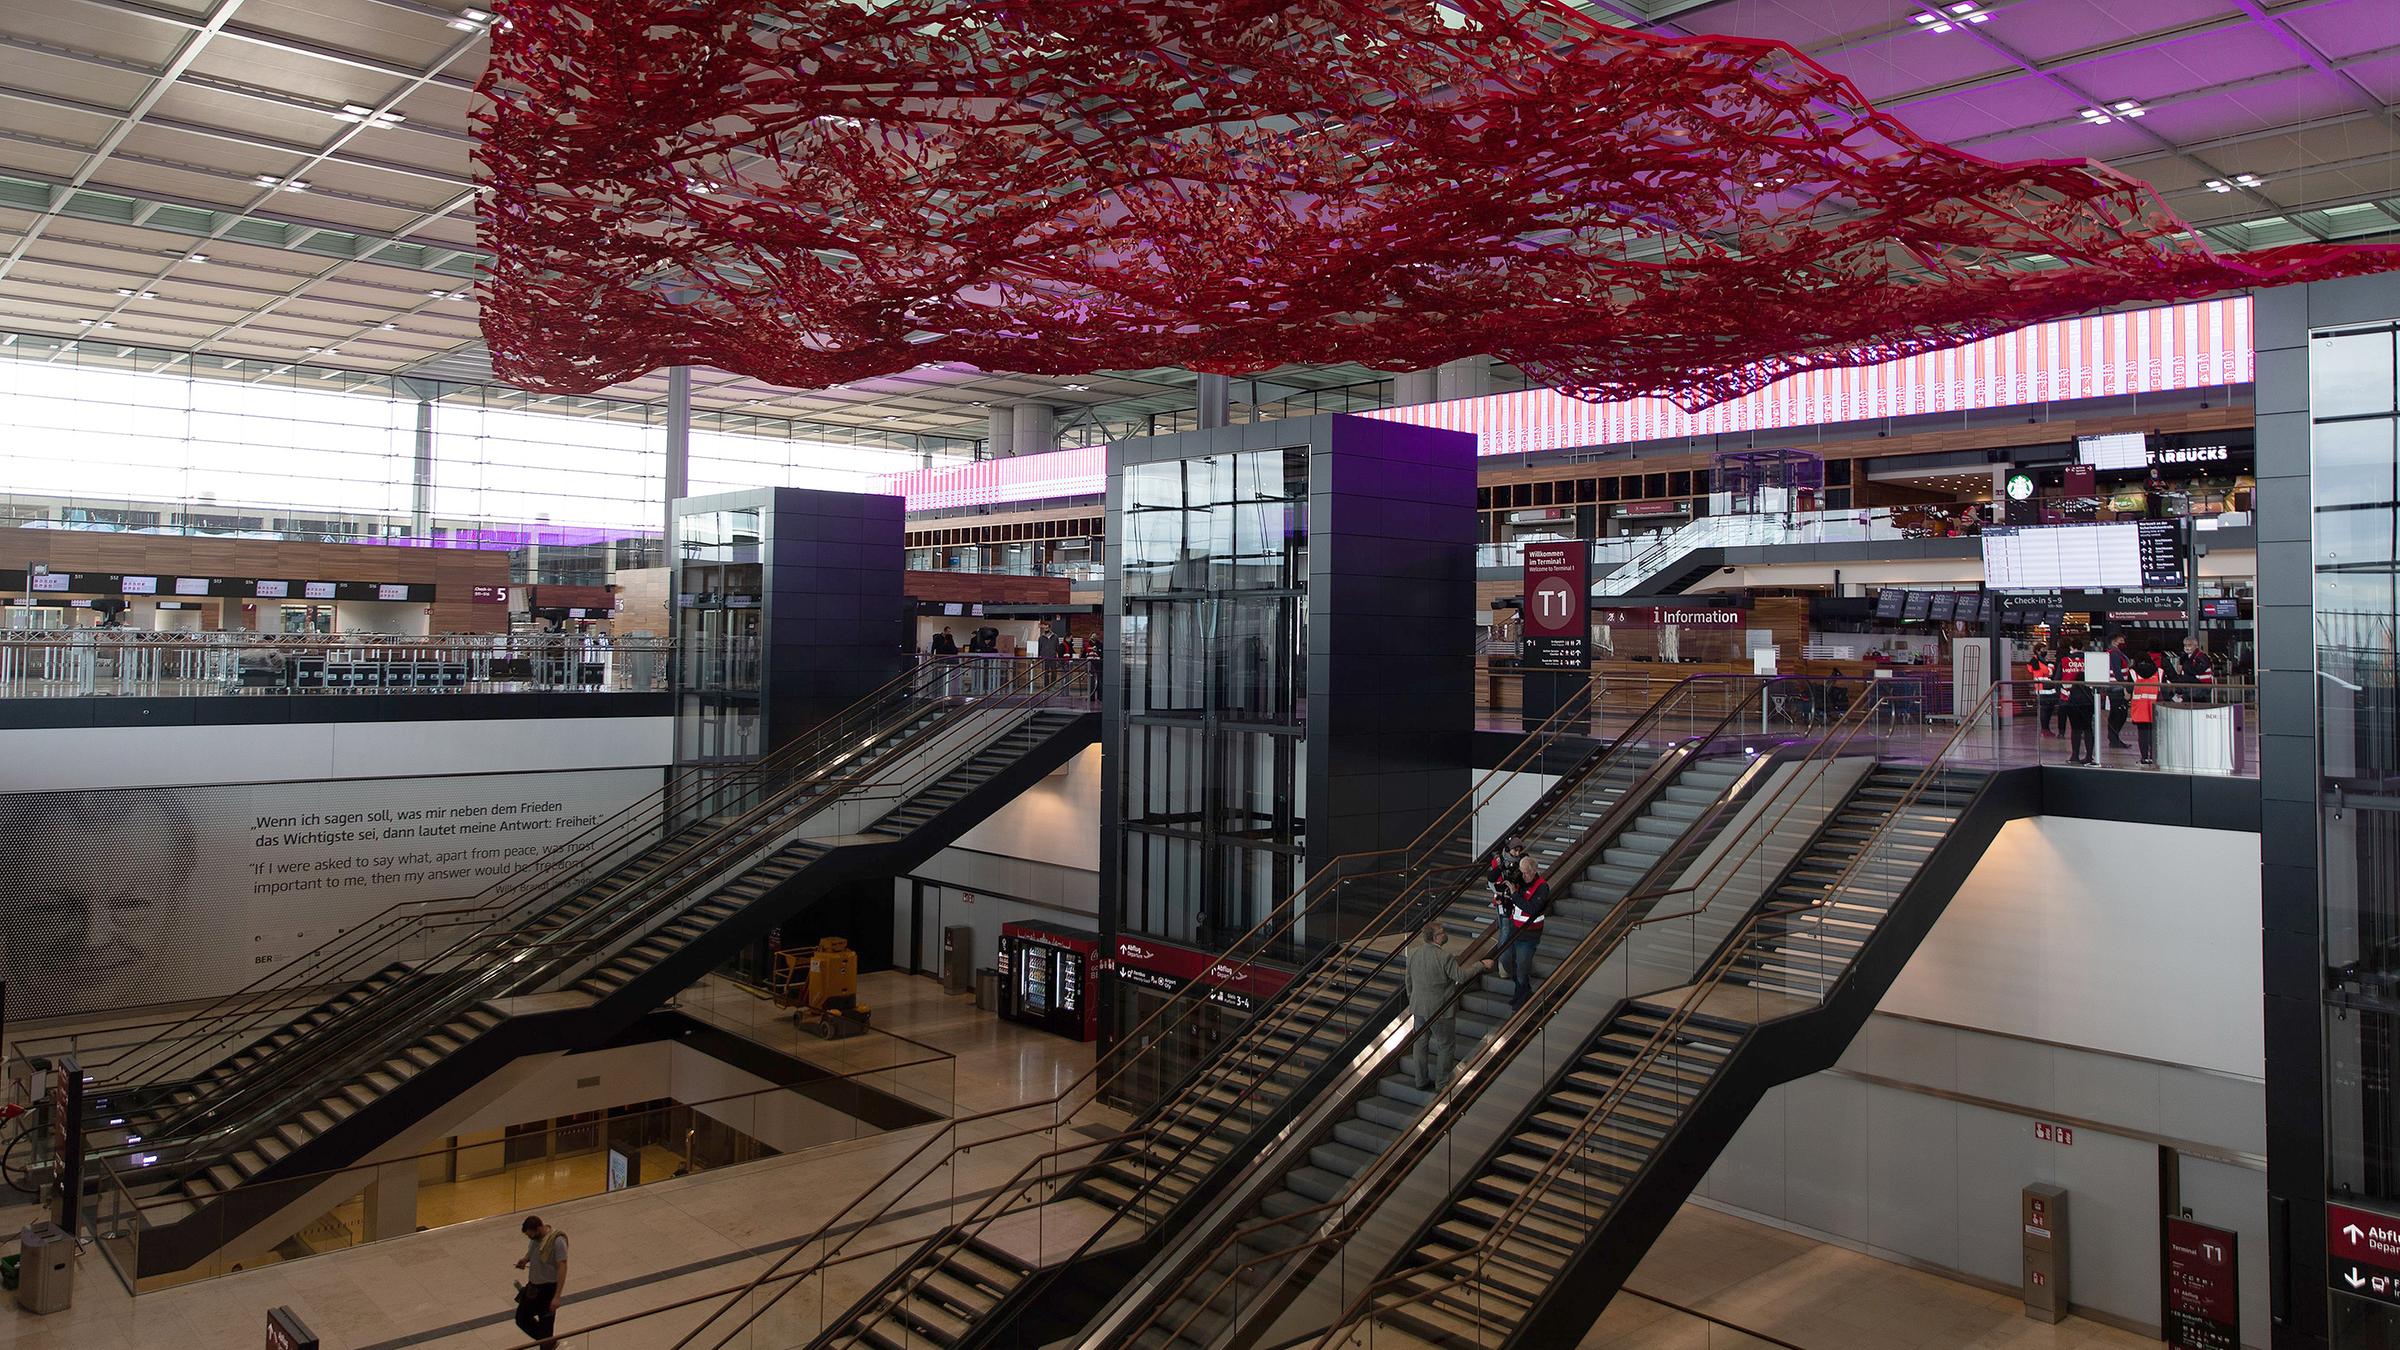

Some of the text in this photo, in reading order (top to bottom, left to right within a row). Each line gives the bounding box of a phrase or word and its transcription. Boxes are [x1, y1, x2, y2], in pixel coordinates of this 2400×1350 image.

[497, 588, 506, 600] 5
[1538, 591, 1566, 616] T1
[1664, 610, 1738, 623] Information
[302, 814, 320, 825] ich
[325, 813, 363, 826] sagen
[368, 810, 393, 823] soll,
[398, 810, 422, 820] was
[426, 807, 446, 819] mir
[450, 805, 487, 817] neben
[492, 804, 516, 815] dem
[521, 801, 562, 814] Frieden
[256, 835, 279, 847] das
[284, 830, 354, 845] Wichtigste
[359, 829, 379, 841] sei,
[383, 827, 414, 839] dann
[419, 824, 455, 836] lautet
[460, 822, 496, 833] meine
[500, 818, 551, 832] Antwort:
[269, 863, 272, 874] I
[278, 862, 310, 873] were
[315, 857, 351, 871] asked
[356, 857, 369, 868] to
[373, 855, 394, 869] say
[398, 852, 432, 865] what,
[436, 851, 467, 864] apart
[472, 848, 500, 859] from
[504, 846, 539, 859] peace,
[542, 844, 564, 854] was
[568, 842, 595, 853] most
[254, 878, 322, 895] important
[327, 877, 339, 888] to
[344, 875, 367, 887] me,
[372, 872, 400, 884] then
[405, 872, 424, 884] my
[428, 867, 471, 880] answer
[475, 863, 510, 875] would
[1237, 996, 1249, 1008] 3-4
[2172, 1244, 2222, 1262] Terminal T1
